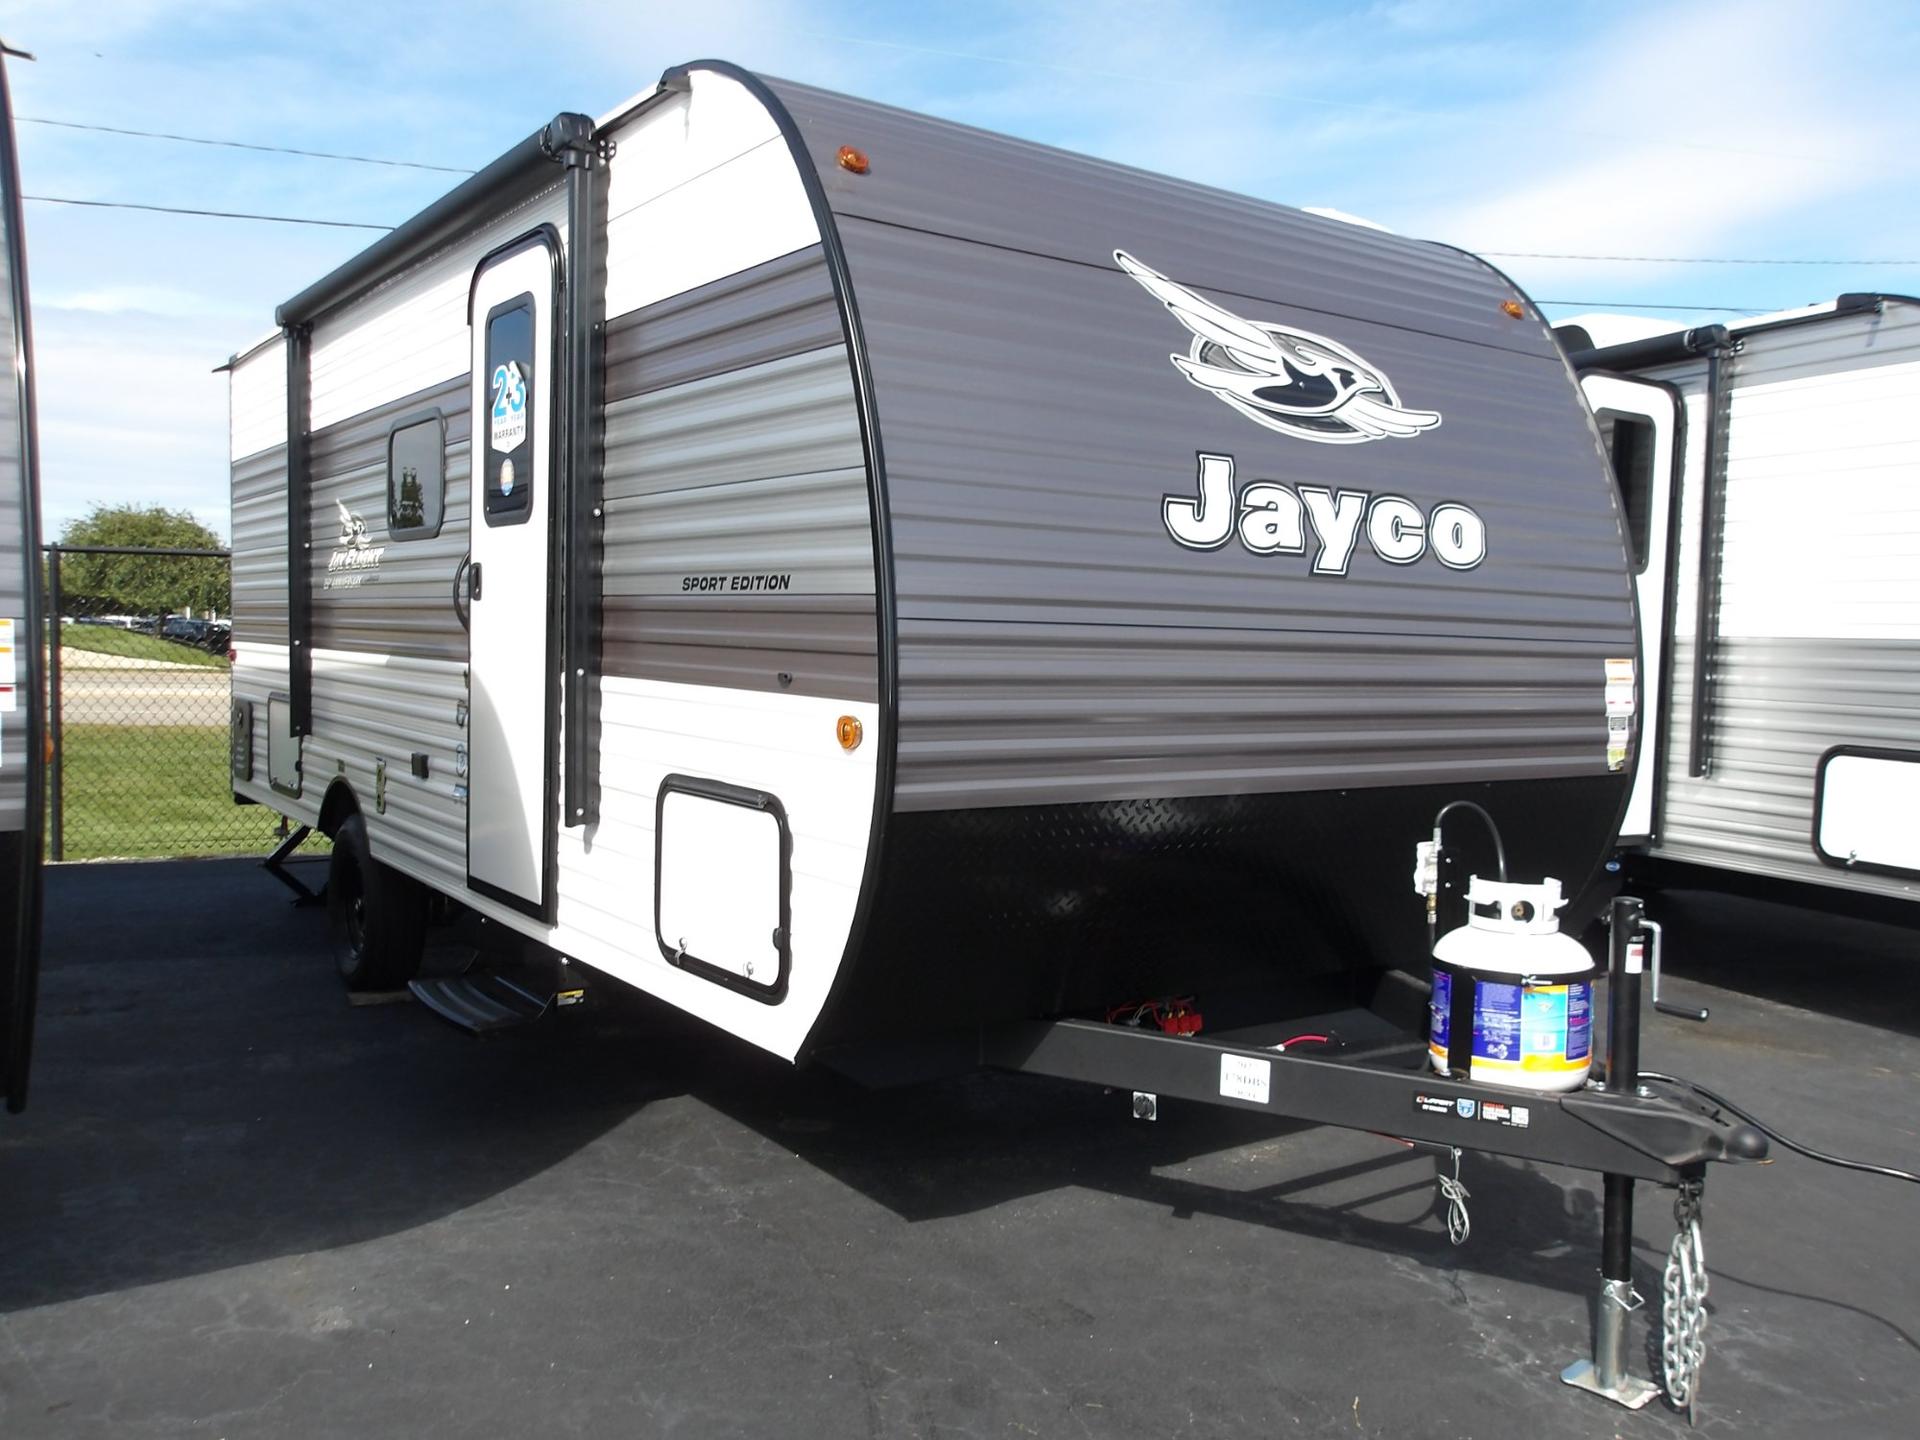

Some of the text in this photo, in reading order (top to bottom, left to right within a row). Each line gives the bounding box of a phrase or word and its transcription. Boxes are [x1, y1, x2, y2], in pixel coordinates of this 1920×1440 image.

[493, 425, 525, 440] WARRANTY
[1161, 450, 1488, 578] Jayco
[682, 574, 791, 591] SPORT EDITION
